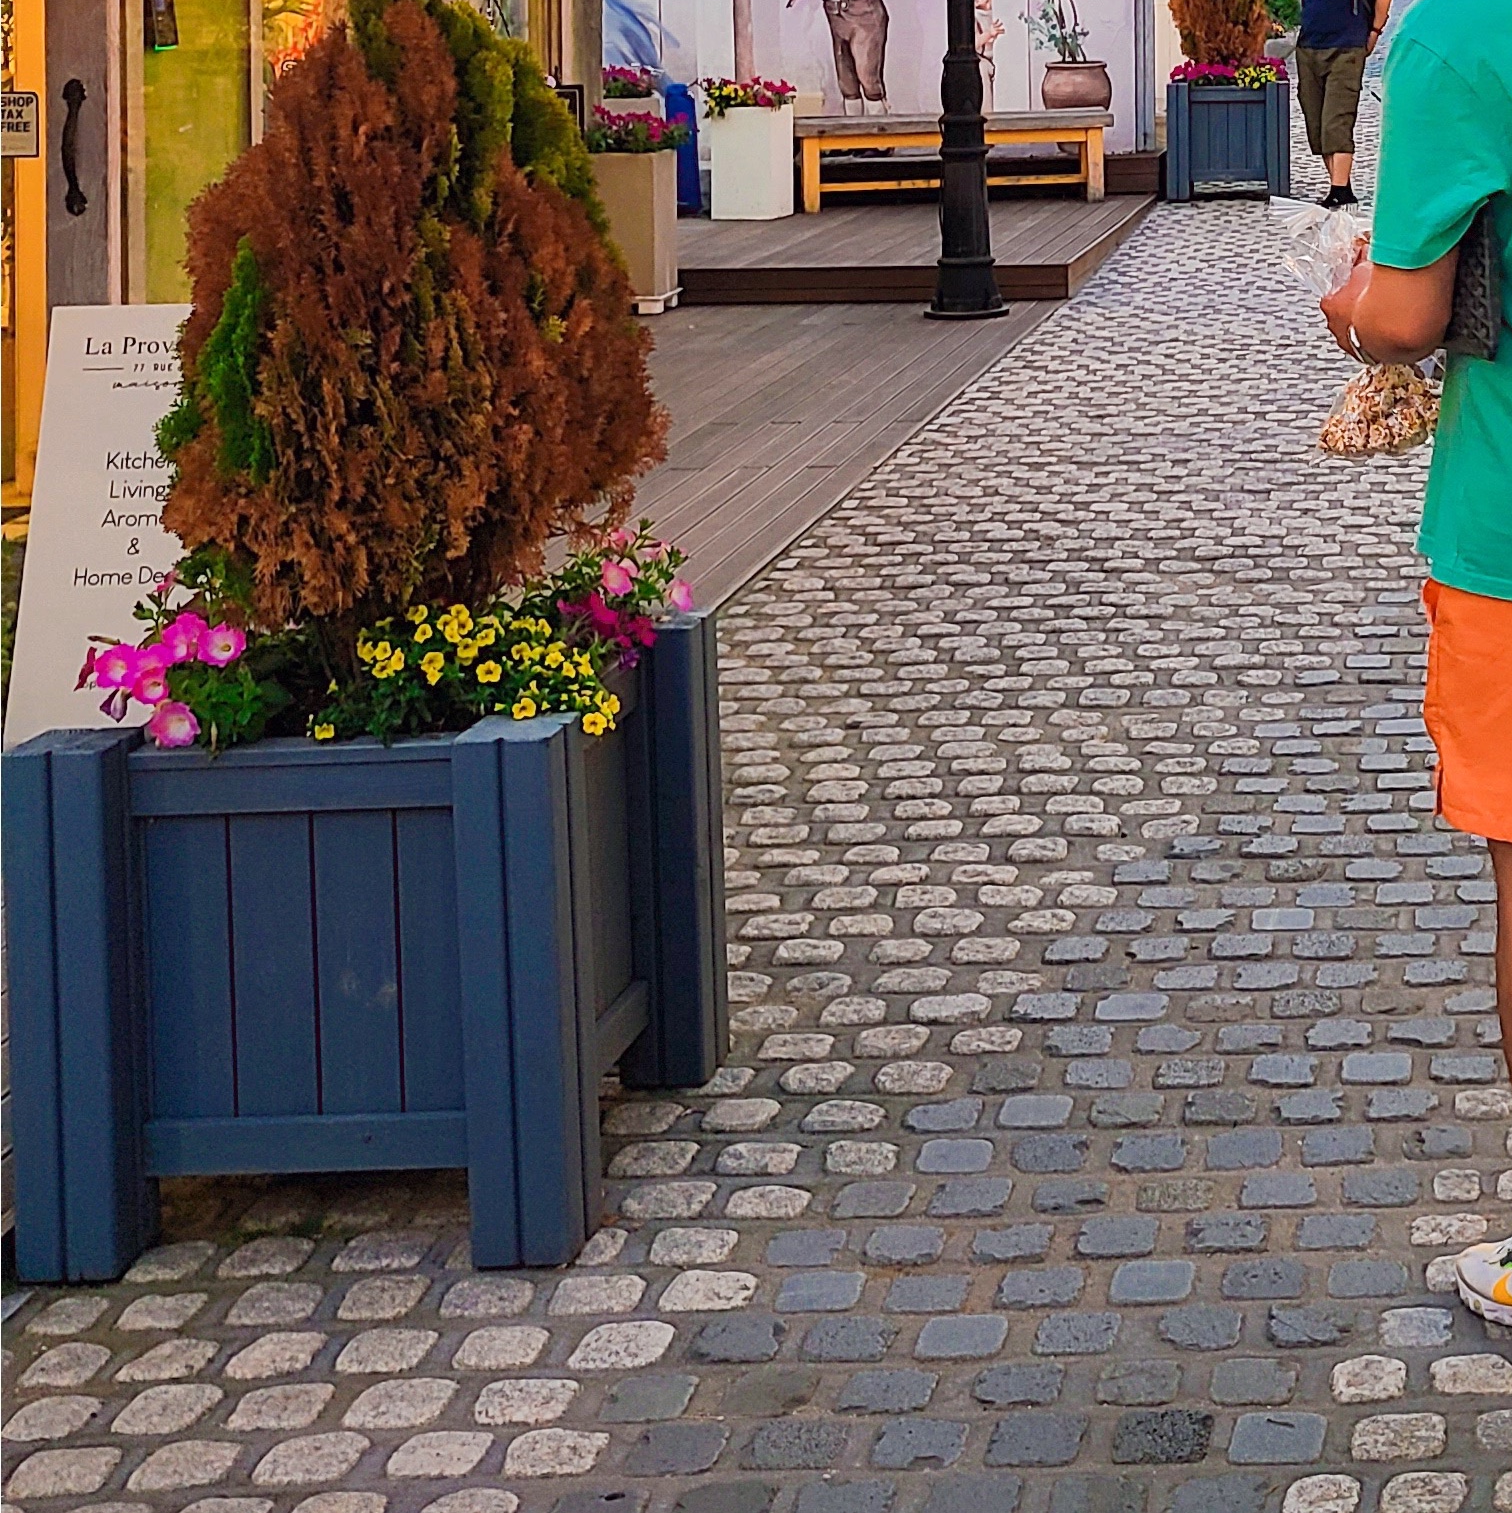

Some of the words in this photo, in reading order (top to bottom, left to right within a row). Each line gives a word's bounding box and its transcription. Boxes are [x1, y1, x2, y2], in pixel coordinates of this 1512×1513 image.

[1, 96, 34, 107] SHOP
[1, 109, 24, 119] TAX
[1, 122, 31, 132] FREE
[85, 337, 112, 355] La
[153, 363, 174, 372] RUE
[109, 480, 168, 502] Living
[127, 537, 140, 555] &
[73, 567, 133, 586] Home
